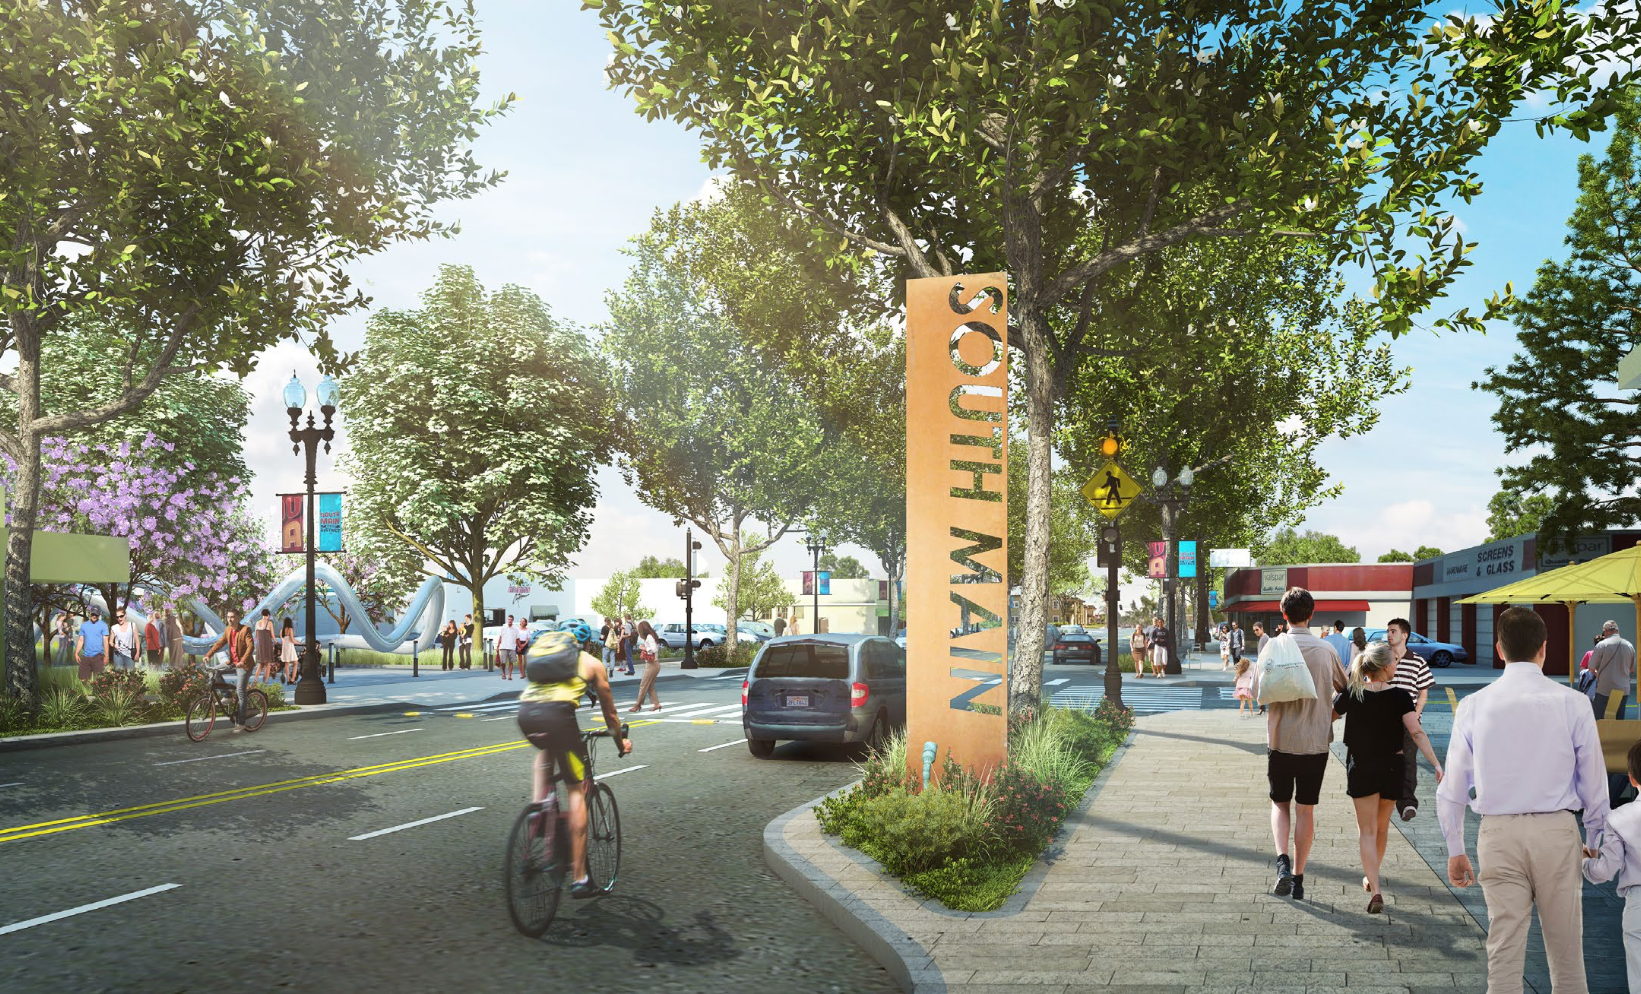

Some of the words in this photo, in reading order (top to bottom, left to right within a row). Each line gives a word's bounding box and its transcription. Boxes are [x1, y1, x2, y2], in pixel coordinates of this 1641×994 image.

[949, 282, 1003, 502] SOUTH
[1476, 567, 1482, 577] &
[1486, 560, 1515, 575] GLASS
[1477, 545, 1514, 563] SCREENS
[949, 526, 1003, 716] MAIN
